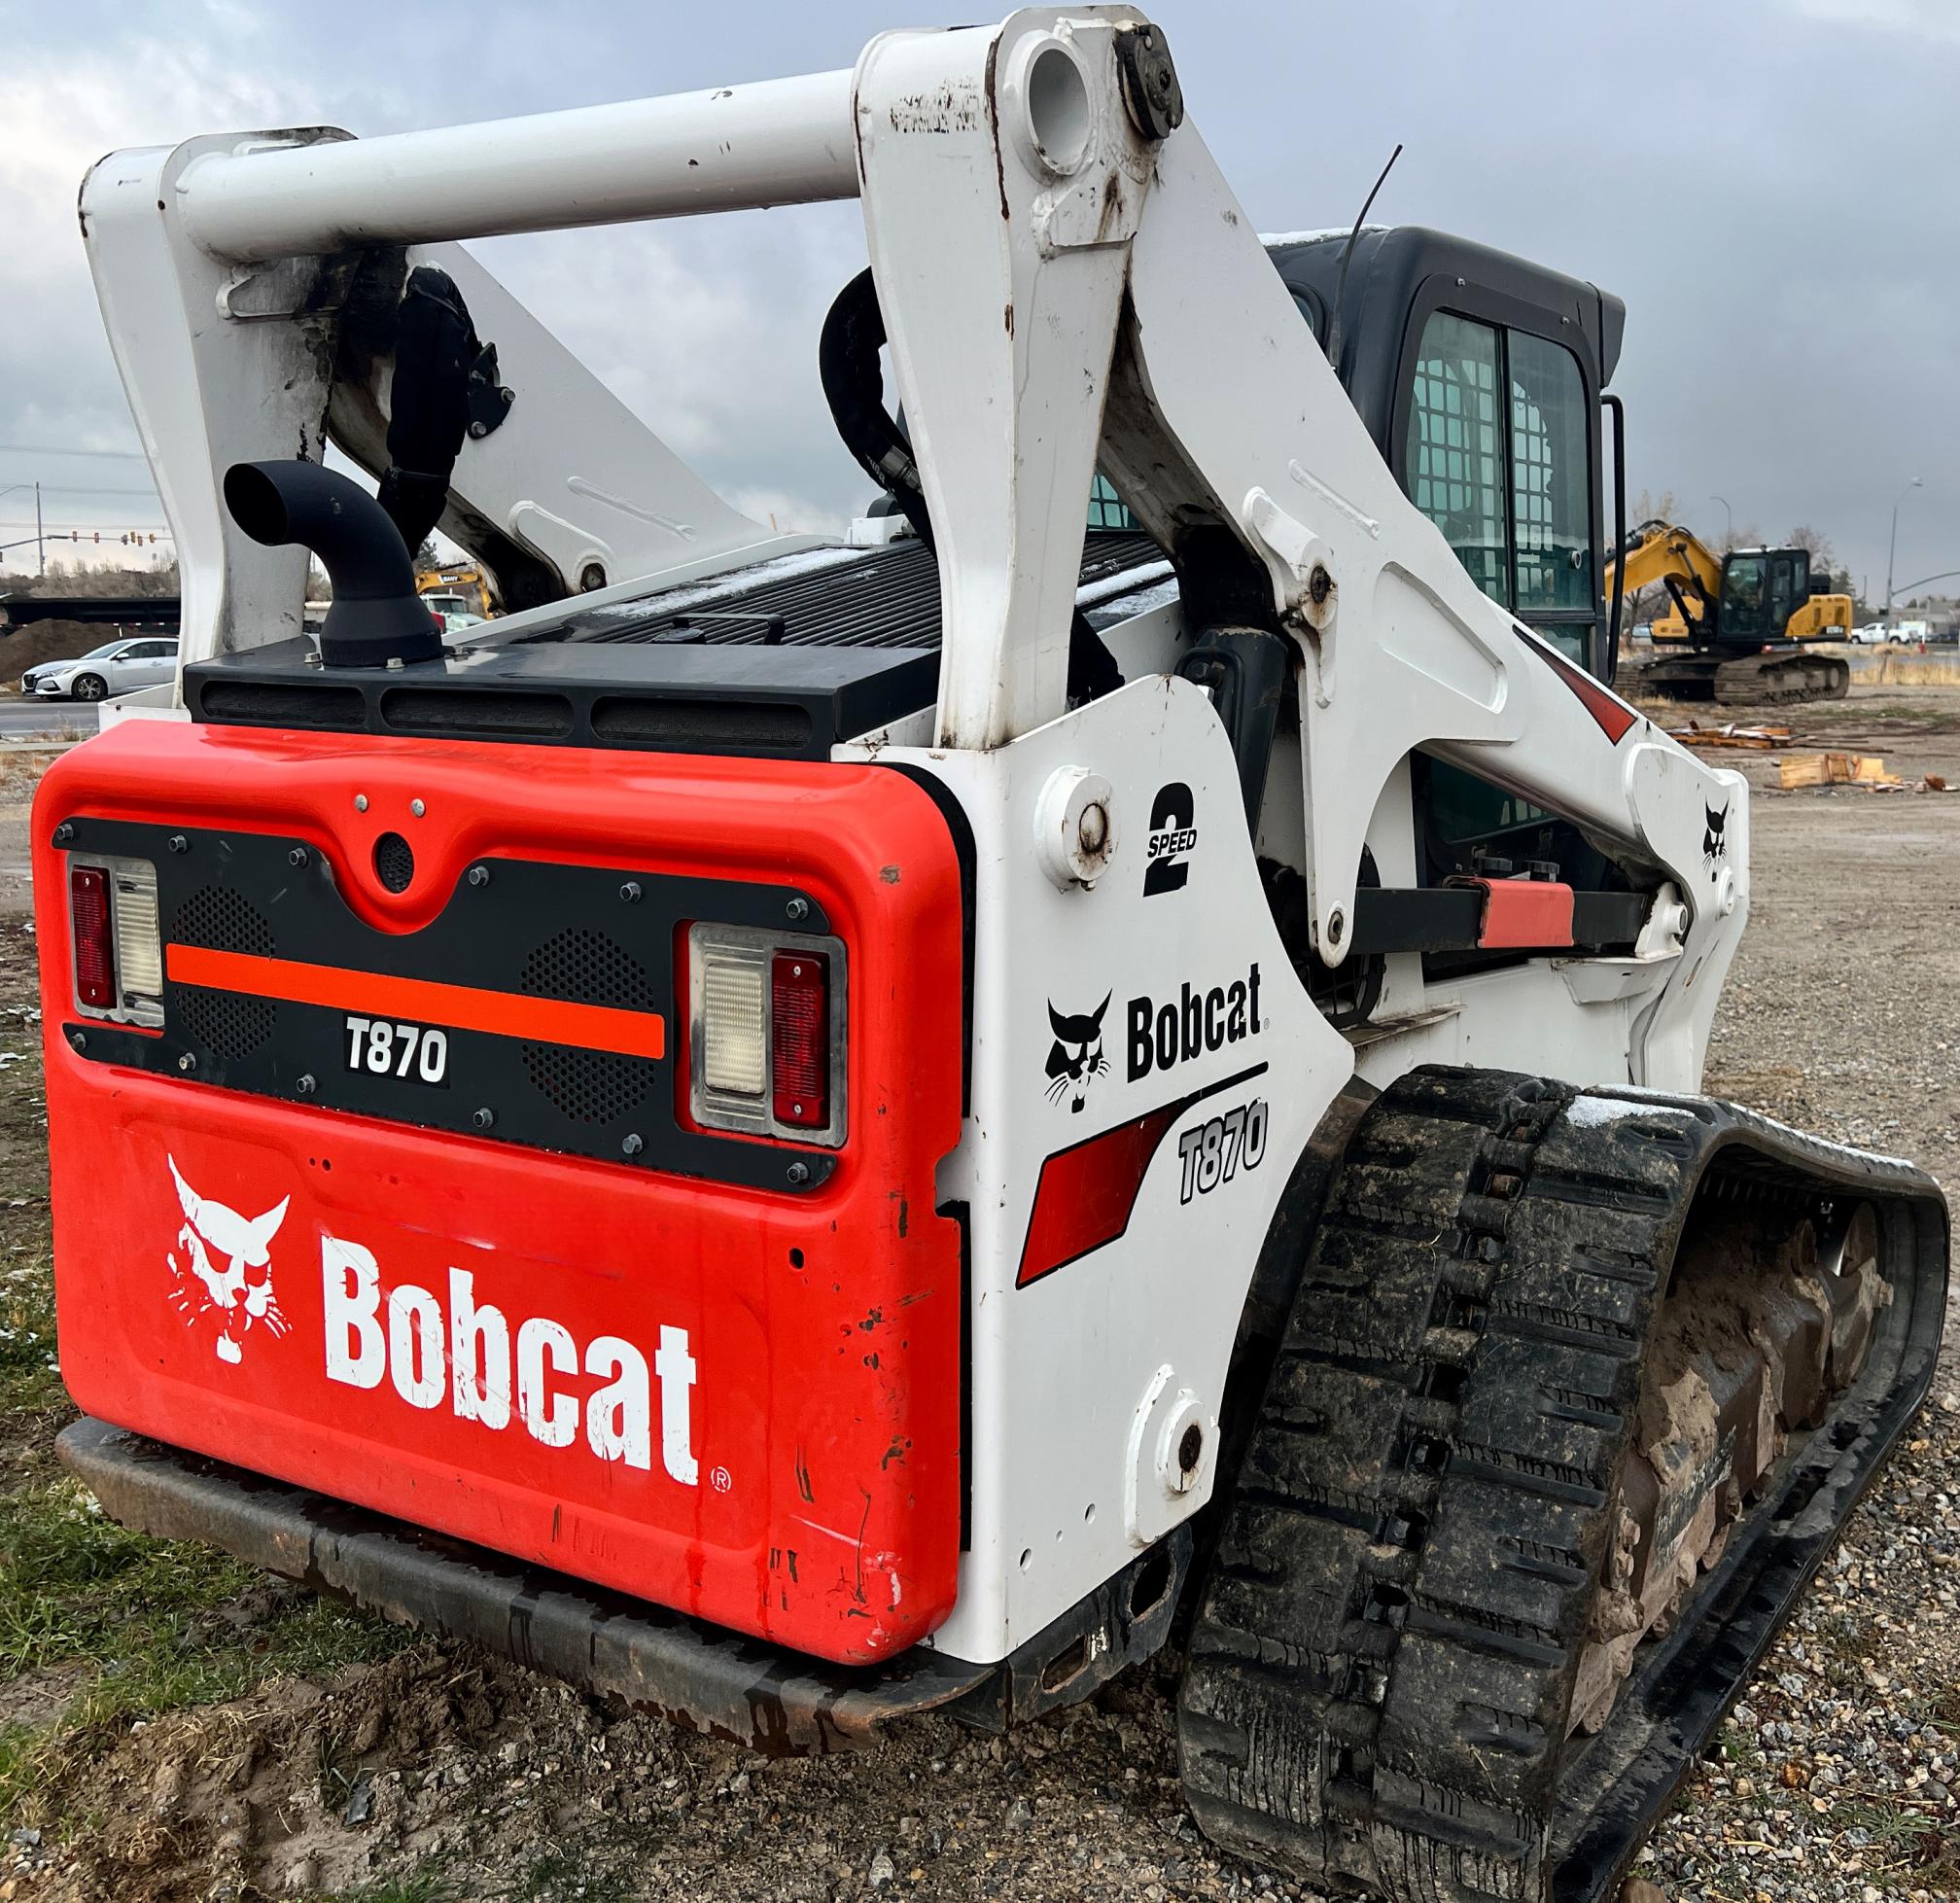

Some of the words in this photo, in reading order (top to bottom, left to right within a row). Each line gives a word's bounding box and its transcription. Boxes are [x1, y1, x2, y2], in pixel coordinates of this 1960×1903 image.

[1143, 782, 1195, 898] 2
[1147, 829, 1198, 859] SPEED
[346, 1016, 447, 1083] T870
[1127, 963, 1261, 1084] Bobcat
[1178, 1097, 1269, 1206] T870
[320, 1234, 699, 1486] Bobcat
